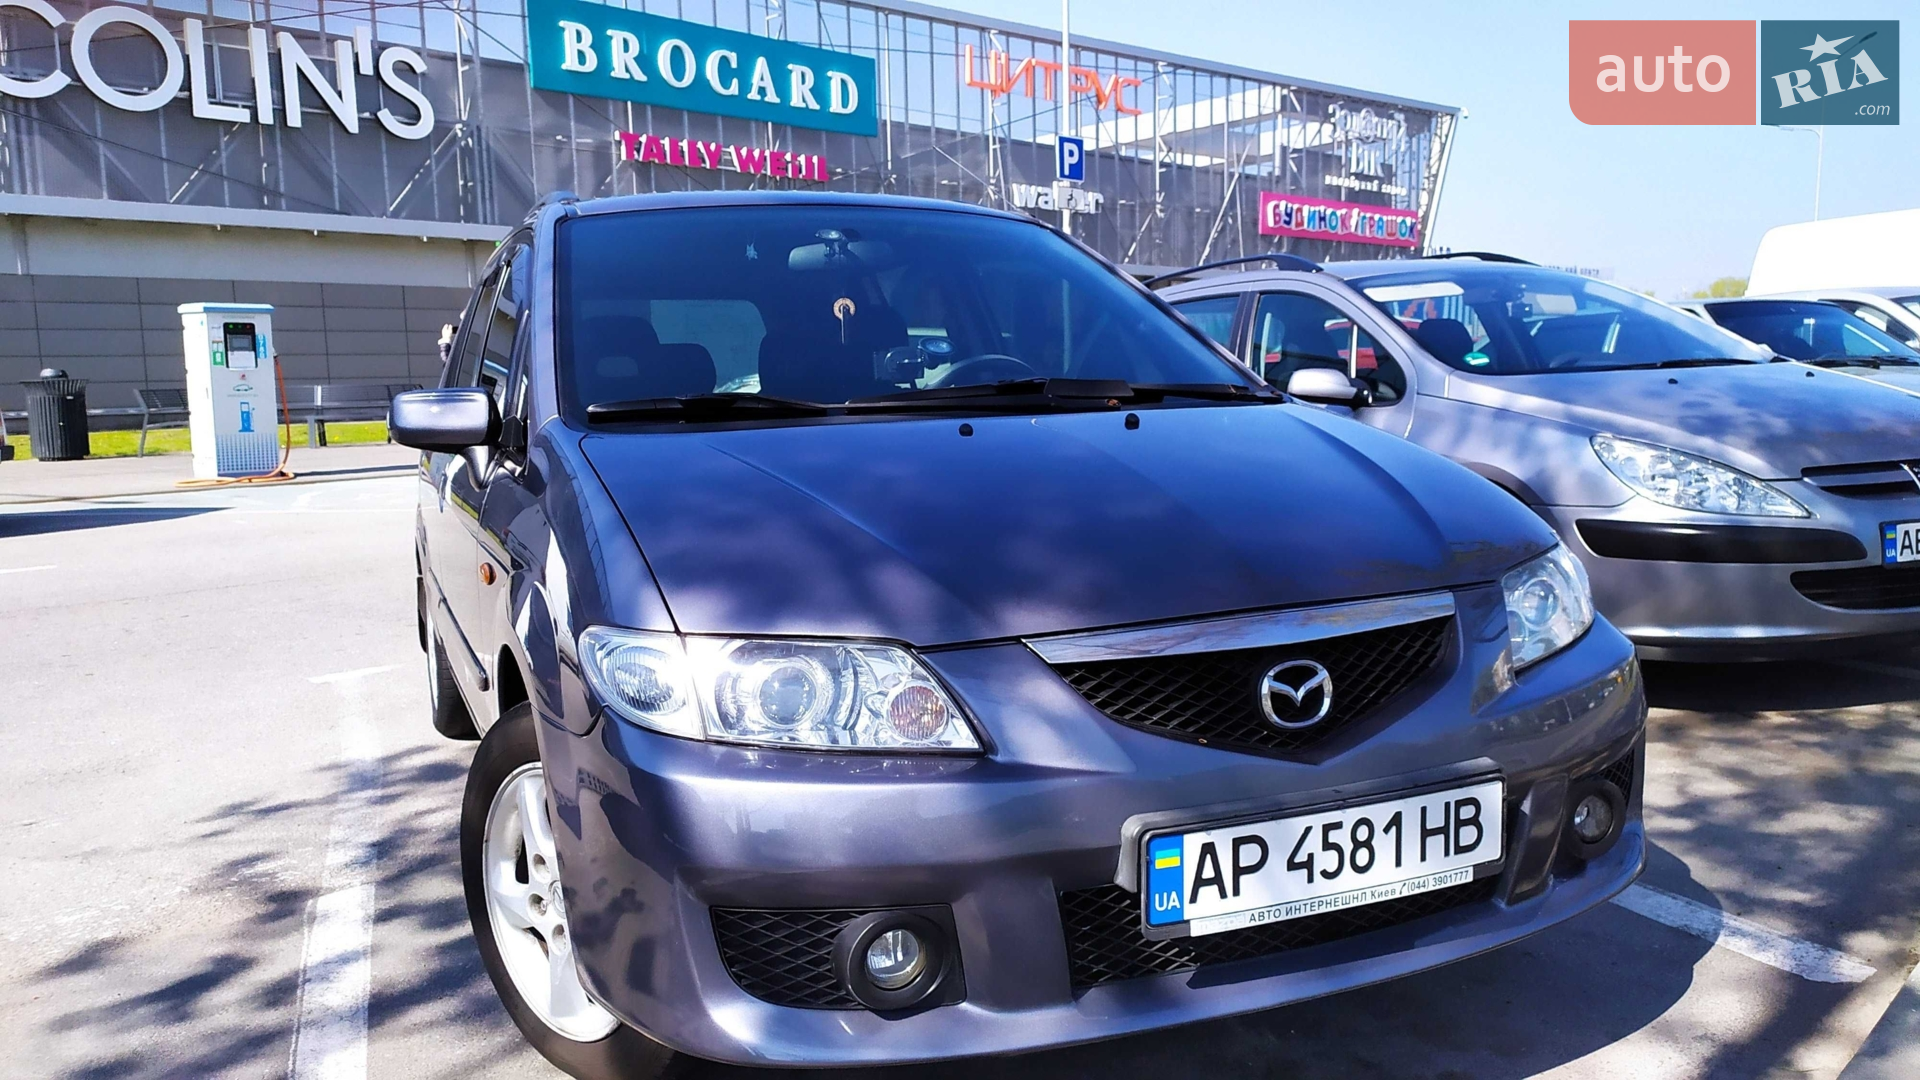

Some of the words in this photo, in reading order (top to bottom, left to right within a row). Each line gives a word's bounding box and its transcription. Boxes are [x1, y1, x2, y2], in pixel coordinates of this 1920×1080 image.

[0, 0, 434, 140] COLIN'S
[559, 20, 858, 114] BROCARD
[965, 44, 1141, 115] ЦИТРУС
[614, 130, 723, 169] TALLY
[1064, 142, 1080, 176] P
[1267, 200, 1349, 235] БУДИНОК
[1350, 207, 1417, 241] ІГРАШОК
[1885, 549, 1896, 558] UA
[1188, 834, 1269, 905] AP
[1286, 810, 1403, 884] 4581
[1420, 797, 1484, 862] HB
[1154, 890, 1180, 912] UA
[1248, 908, 1282, 924] АВТО
[1285, 891, 1367, 917] ИНТЕРНЕШНЛ
[1370, 887, 1396, 901] Киев
[1407, 879, 1430, 894] (044)
[1432, 870, 1469, 887] 3901777
